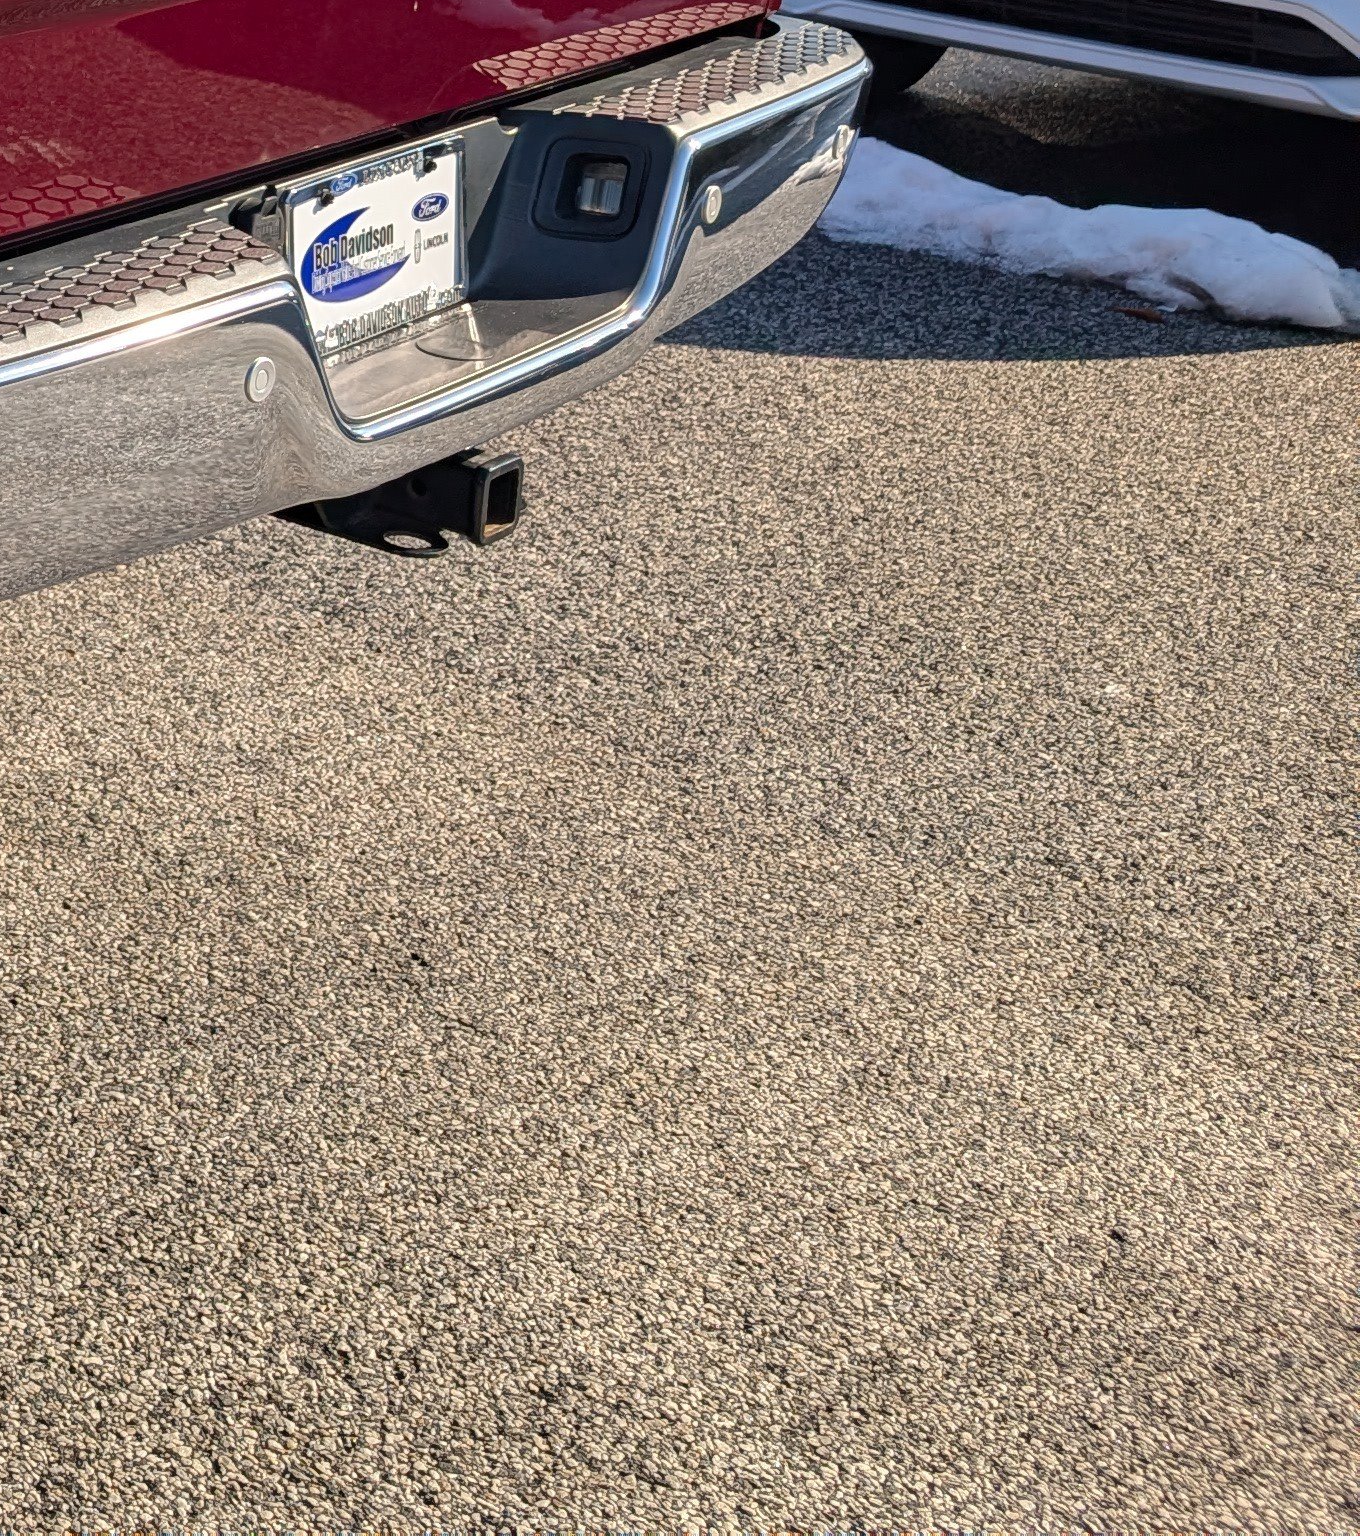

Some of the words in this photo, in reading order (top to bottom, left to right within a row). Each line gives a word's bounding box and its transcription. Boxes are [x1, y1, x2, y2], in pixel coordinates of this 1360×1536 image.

[416, 196, 444, 218] Ford
[313, 238, 338, 271] Bob
[340, 222, 394, 262] Davidson
[423, 232, 449, 251] LINCOLN
